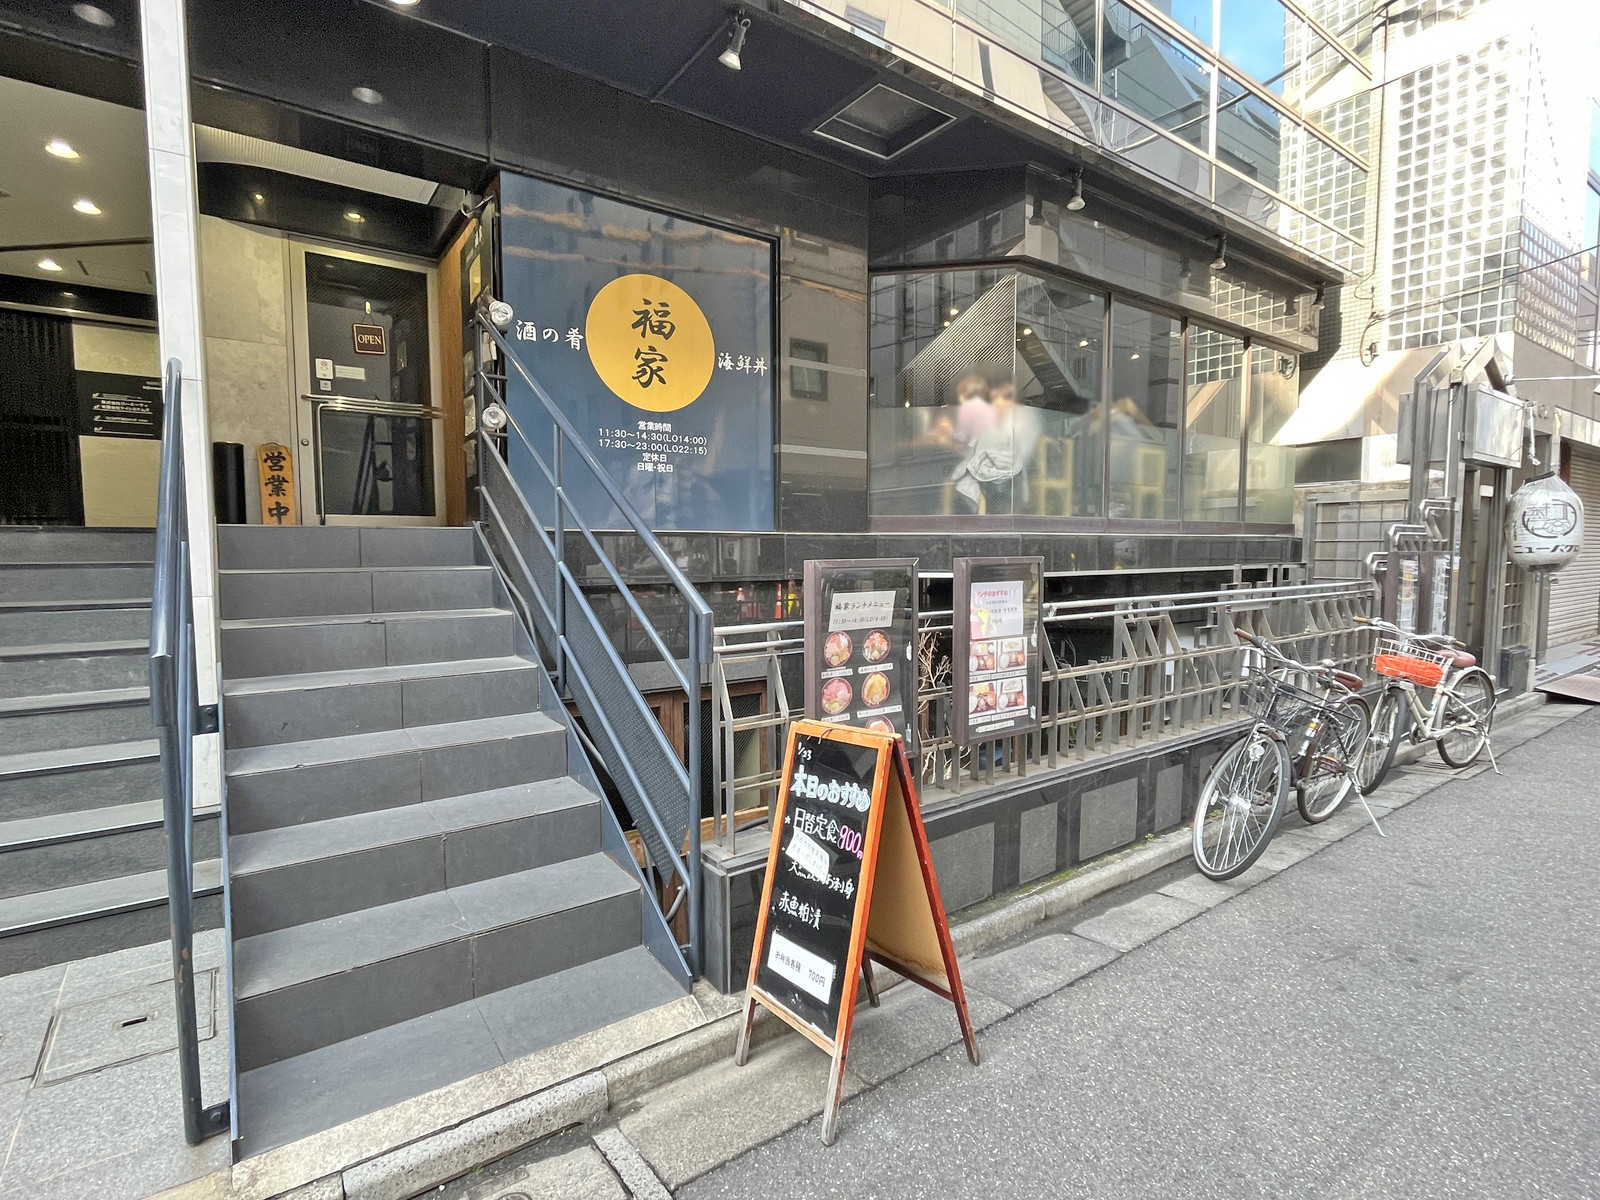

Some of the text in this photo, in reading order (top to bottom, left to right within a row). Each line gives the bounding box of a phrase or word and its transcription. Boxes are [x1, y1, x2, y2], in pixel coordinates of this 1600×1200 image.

[357, 334, 382, 345] OPEN
[515, 319, 584, 351] 酒の肴
[631, 297, 676, 389] 福家
[717, 352, 768, 377] 海鮮丼
[637, 420, 672, 432] 営業時間
[642, 452, 667, 463] 定休日
[263, 451, 290, 525] 営業中
[797, 741, 813, 760] 1/23
[790, 764, 871, 812] 本日のおすすめ
[808, 969, 826, 988] 700円
